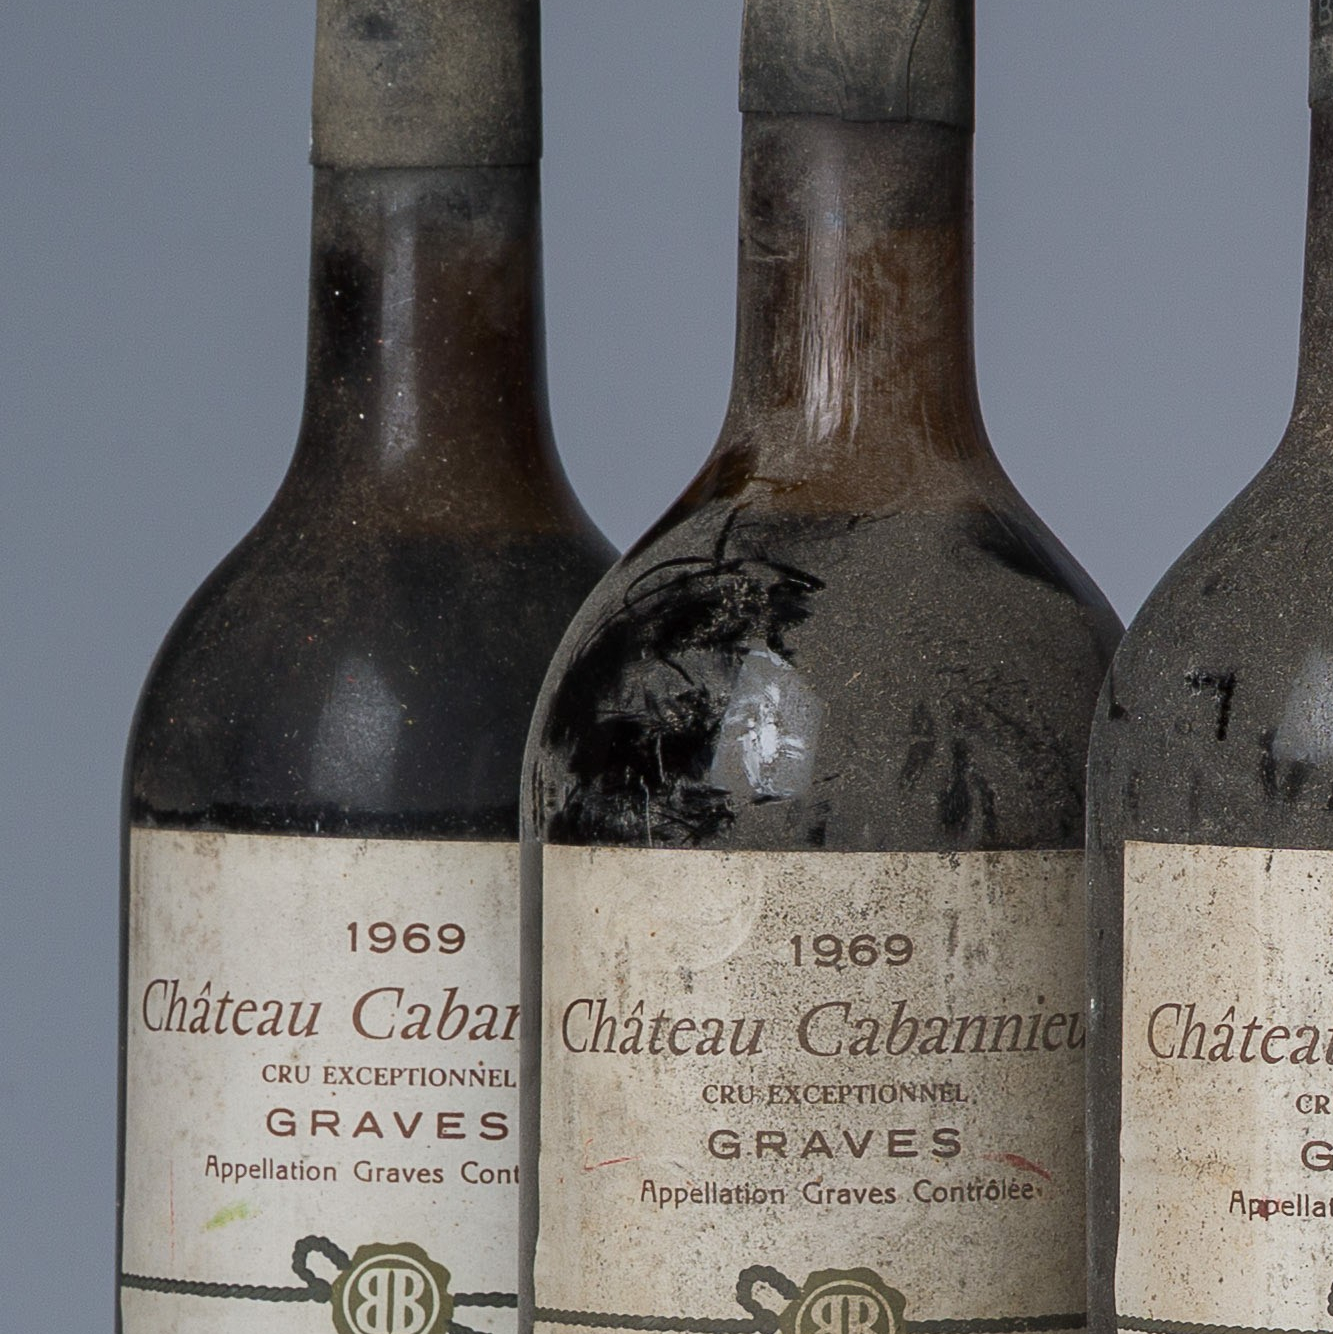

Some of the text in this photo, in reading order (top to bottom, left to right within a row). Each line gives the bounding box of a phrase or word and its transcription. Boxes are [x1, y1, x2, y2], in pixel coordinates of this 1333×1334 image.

[346, 921, 466, 955] 1969
[790, 933, 914, 968] 1969
[142, 978, 323, 1038] Château
[561, 995, 1087, 1058] Château Cabannieu
[261, 1064, 517, 1089] CRU EXCEPTIONNEL
[701, 1082, 970, 1106] CRU EXCEPTIONNEL
[266, 1107, 510, 1141] GRAVES
[707, 1127, 963, 1160] GRAVES
[204, 1154, 337, 1185] Appellation
[353, 1160, 445, 1185] Graves
[640, 1177, 1034, 1209] Appellation Graves Contrôlée
